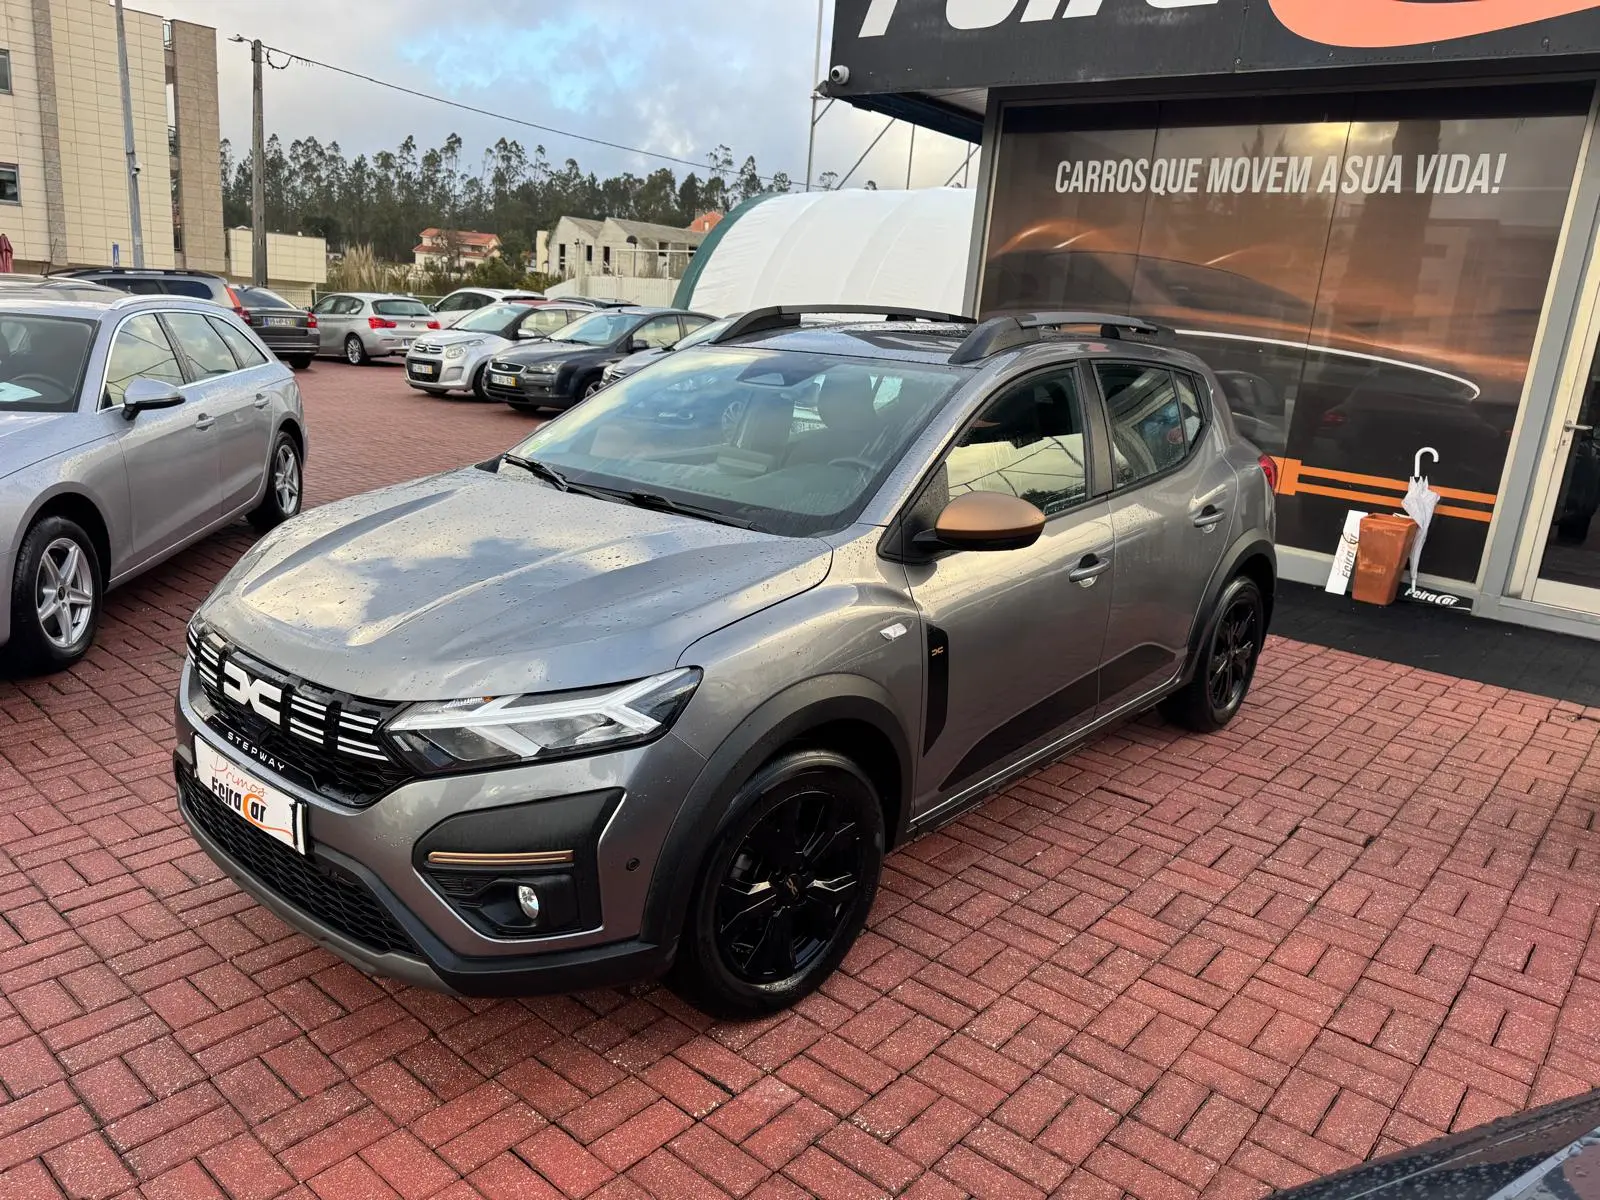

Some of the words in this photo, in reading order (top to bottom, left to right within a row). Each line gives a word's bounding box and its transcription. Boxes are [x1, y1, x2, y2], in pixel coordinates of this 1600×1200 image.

[1055, 158, 1149, 193] CARROS
[1150, 158, 1202, 195] QUE
[1206, 156, 1313, 194] MOVEM
[1416, 153, 1507, 194] VIDA!
[227, 731, 285, 771] STEPWAY
